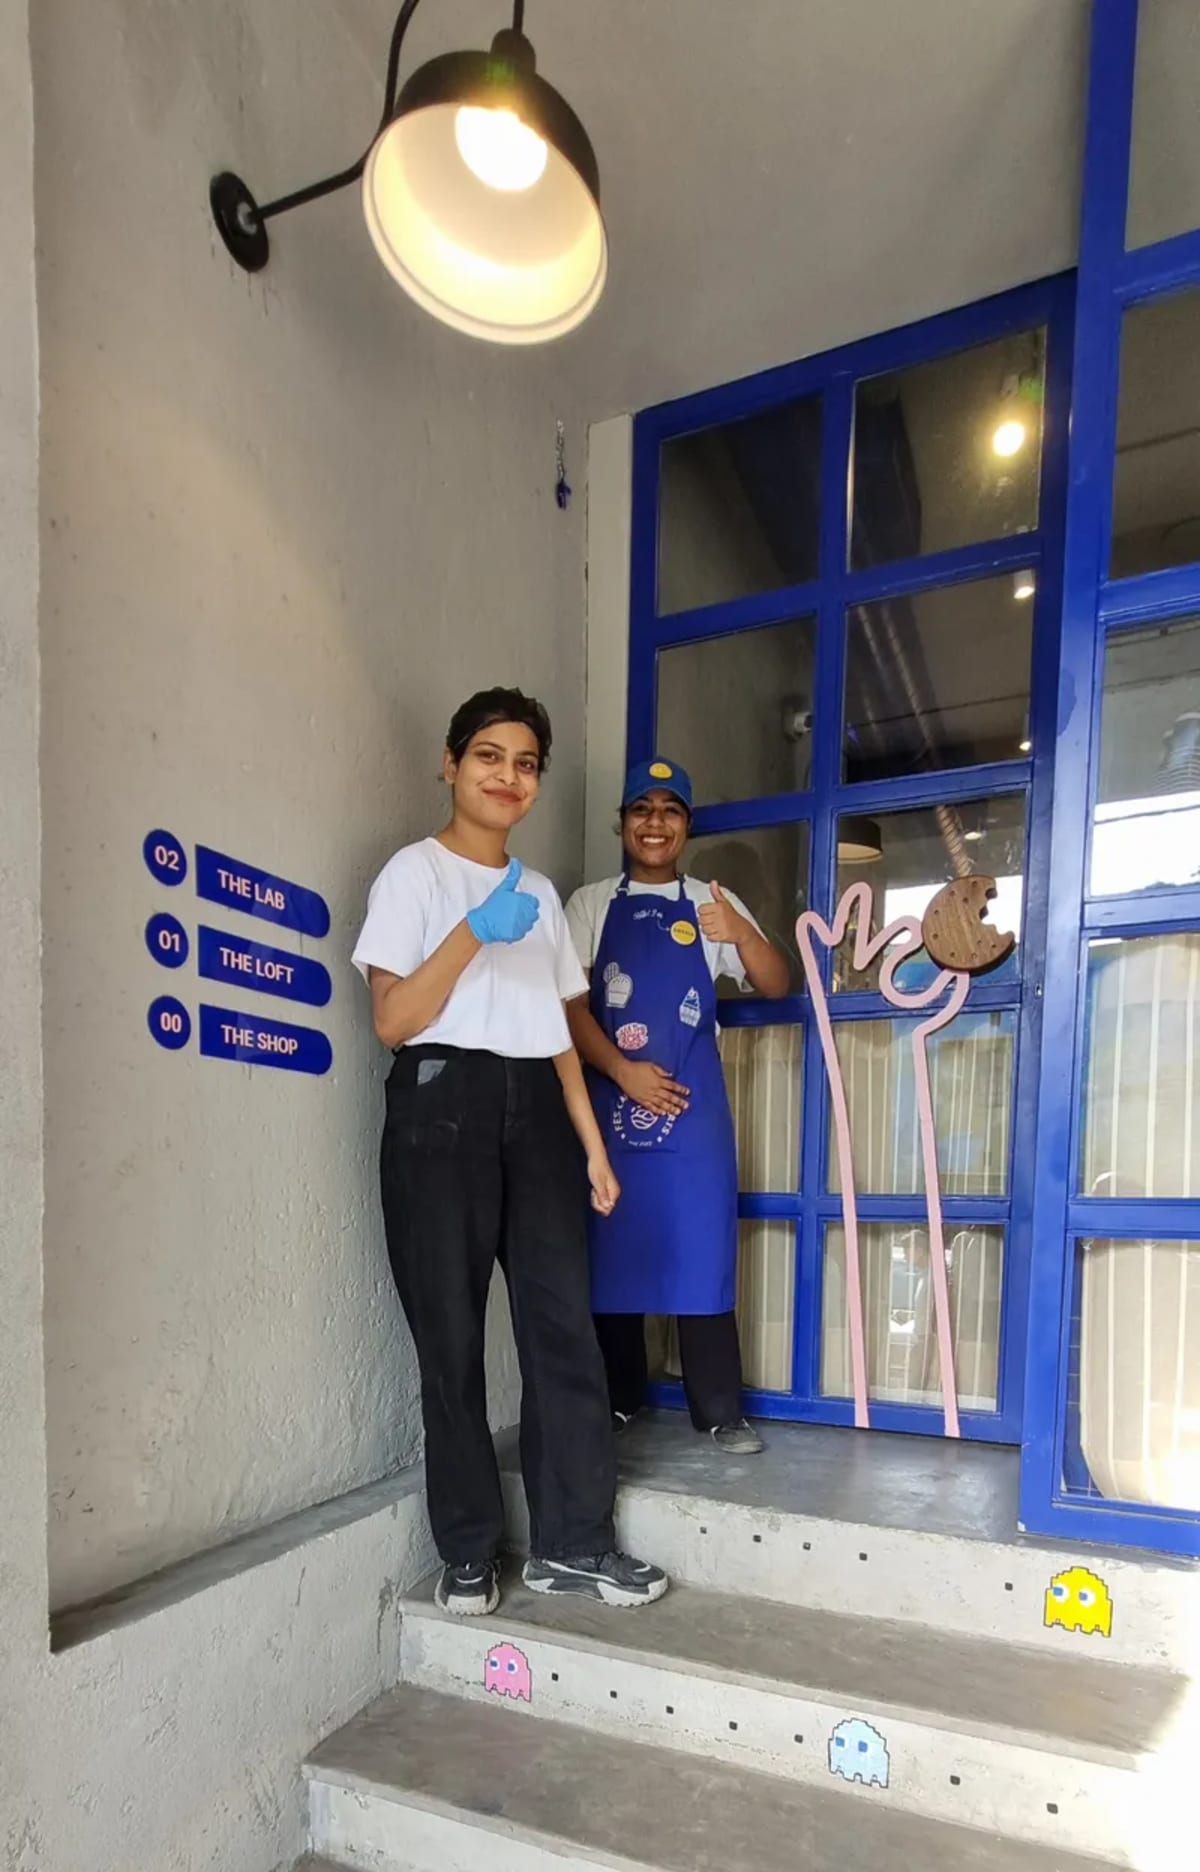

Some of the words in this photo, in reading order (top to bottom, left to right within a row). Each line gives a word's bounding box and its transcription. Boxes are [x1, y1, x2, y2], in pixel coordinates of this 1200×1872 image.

[154, 845, 179, 870] 02
[217, 869, 251, 898] THE
[254, 883, 285, 911] LAB
[158, 929, 180, 953] 01
[219, 947, 252, 973] THE
[255, 958, 294, 984] LOFT
[160, 1012, 182, 1033] 00
[220, 1024, 253, 1048] THE
[256, 1032, 298, 1055] SHOP
